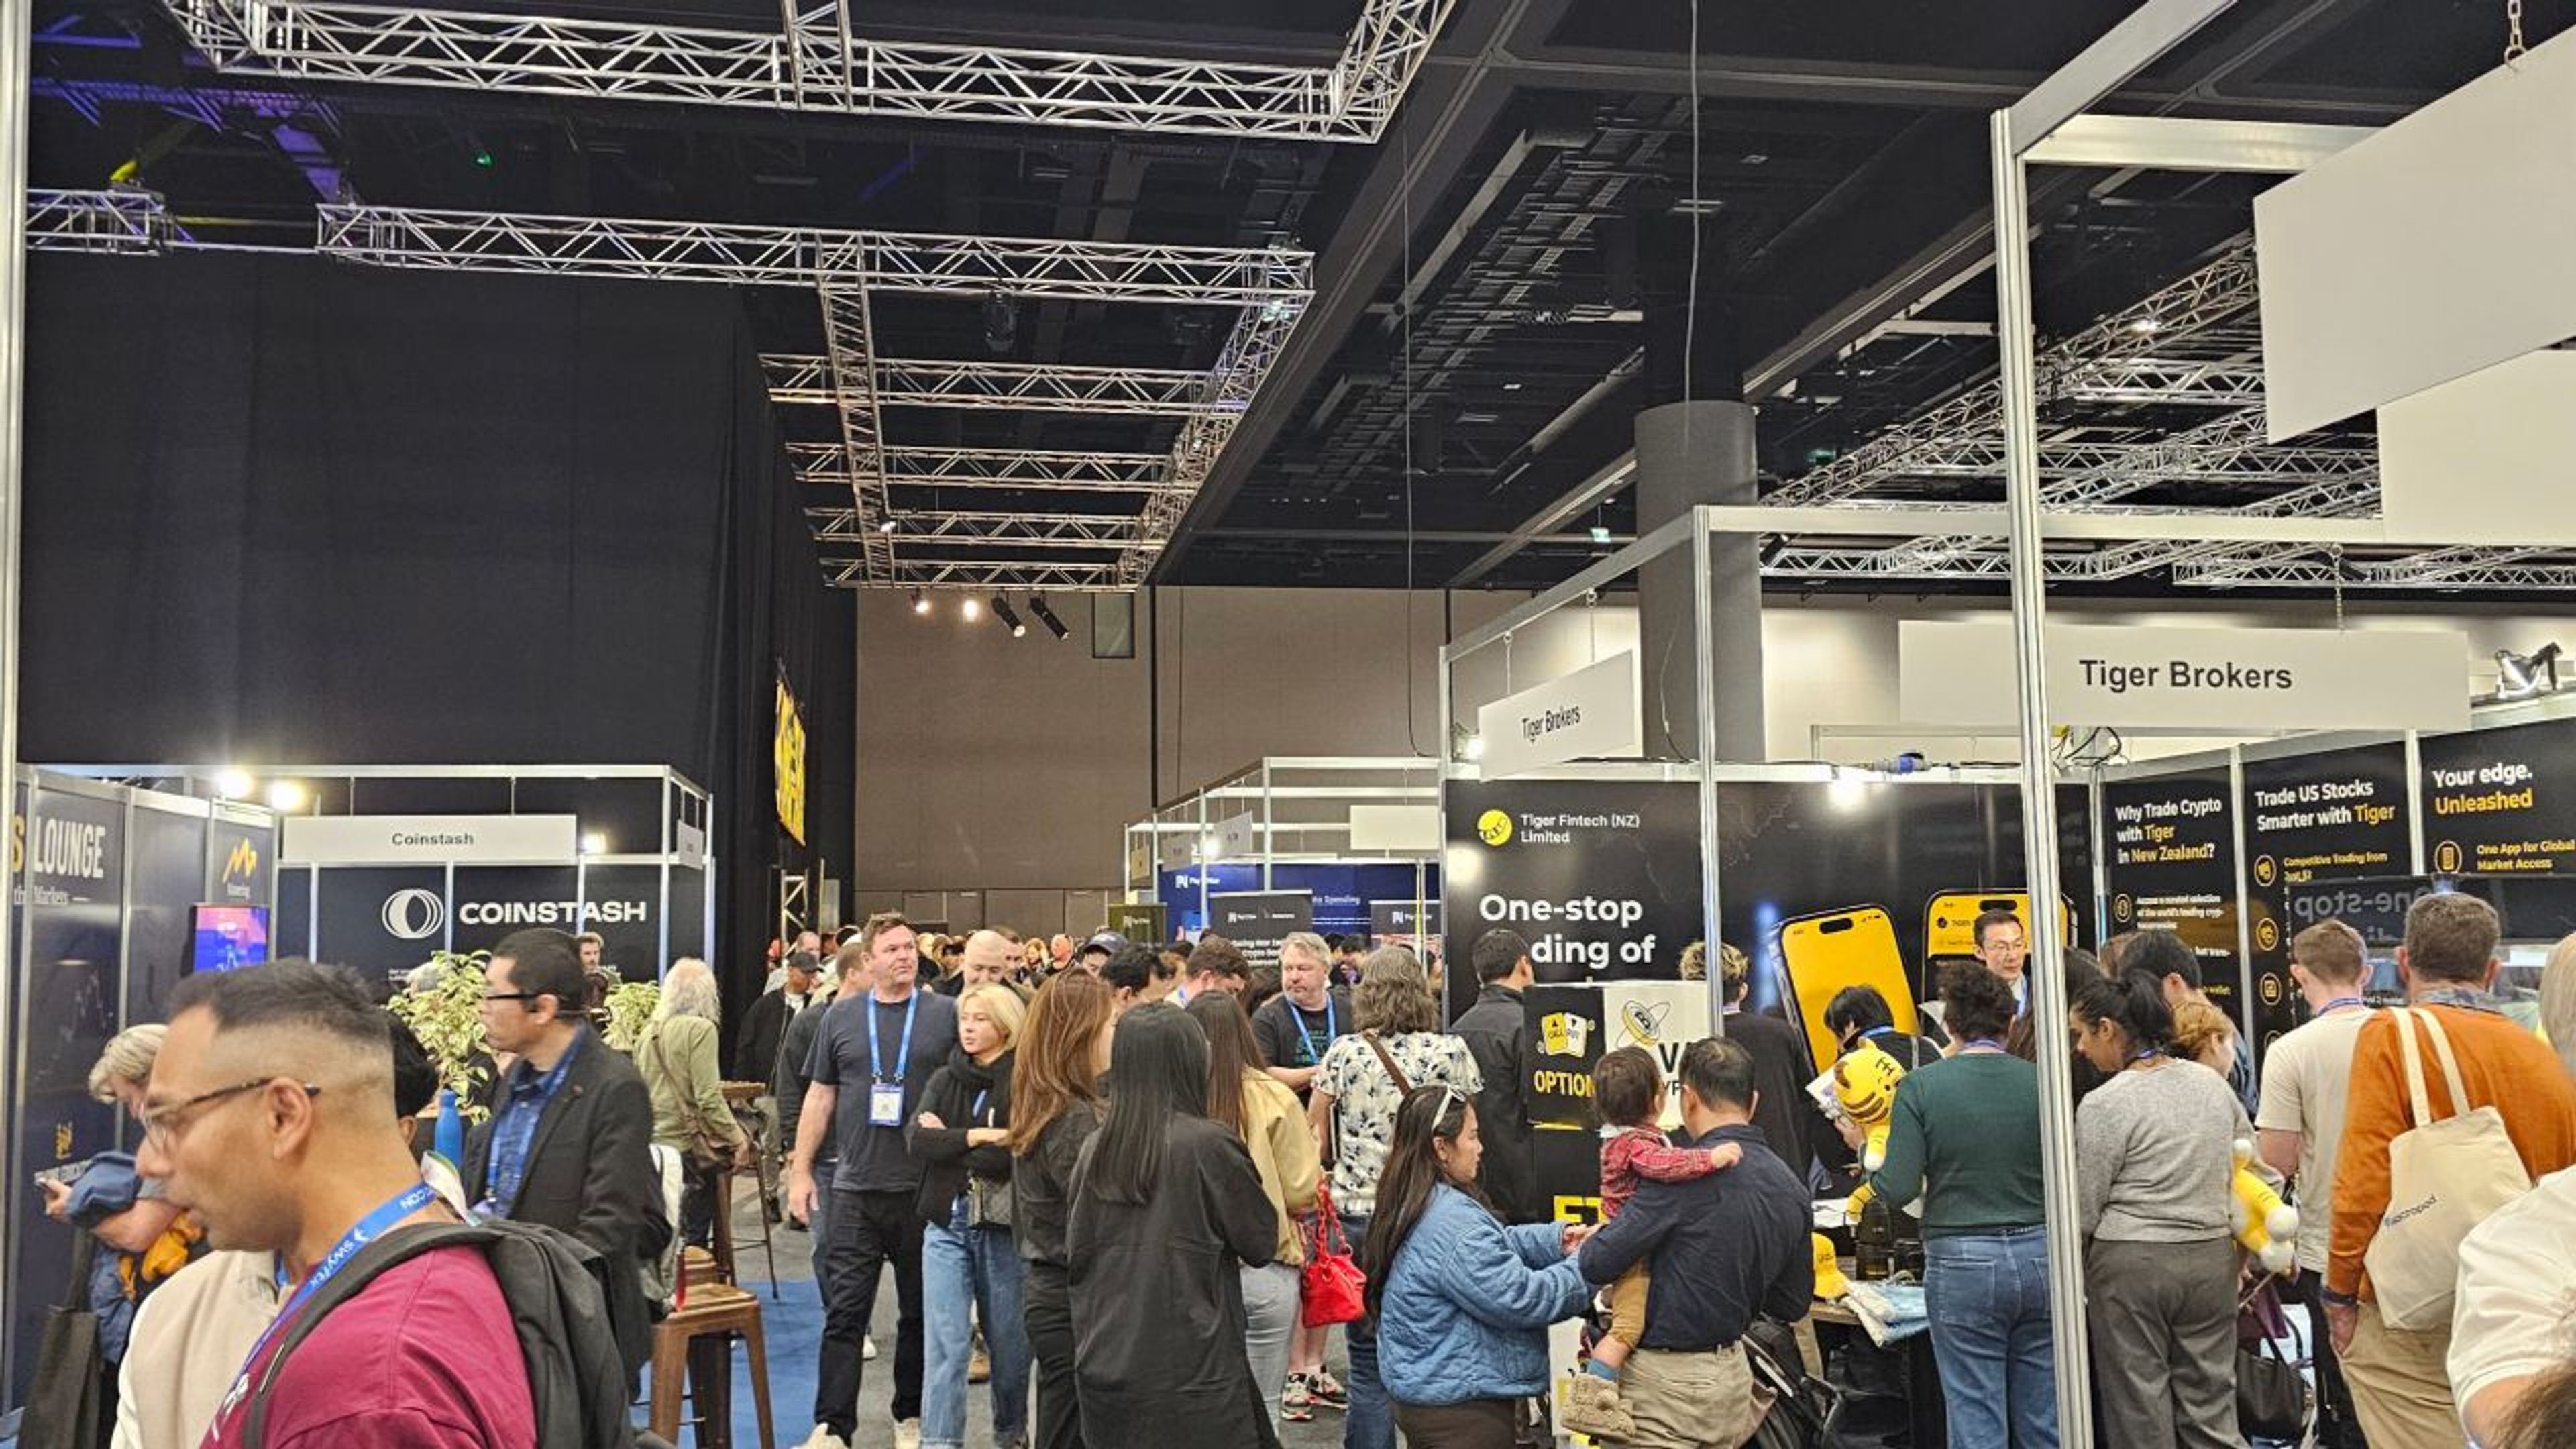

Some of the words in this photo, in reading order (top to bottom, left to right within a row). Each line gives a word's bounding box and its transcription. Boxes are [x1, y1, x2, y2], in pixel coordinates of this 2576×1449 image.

[2079, 659, 2159, 693] Tiger
[2170, 661, 2292, 689] Brokers
[1521, 717, 1544, 744] Tiger
[1545, 704, 1580, 733] Brokers
[2432, 769, 2476, 788] Your
[2479, 762, 2533, 786] edge.
[2255, 788, 2296, 808] Trade
[2299, 784, 2320, 802] US
[2322, 778, 2374, 800] Stocks
[2434, 787, 2534, 814] Unleashed
[1520, 813, 1556, 829] Tiger
[1560, 813, 1607, 827] Fintech
[1611, 813, 1640, 828] (NZ)
[2115, 805, 2143, 823] Why
[2144, 801, 2178, 818] Trade
[2181, 798, 2222, 817] Crypto
[2257, 812, 2314, 833] Smarter
[2317, 806, 2352, 826] with
[2354, 803, 2396, 825] Tiger
[392, 832, 474, 846] Coinstash
[1521, 830, 1570, 843] Limited
[2116, 825, 2143, 843] with
[2145, 823, 2175, 843] Tiger
[34, 816, 106, 879] LOUNGE
[2117, 848, 2130, 865] in
[2131, 848, 2158, 863] New
[2159, 843, 2216, 861] Zealand?
[2477, 845, 2499, 855] One
[2500, 843, 2522, 856] App
[2523, 841, 2539, 853] for
[2540, 839, 2575, 853] Global
[459, 901, 647, 925] COINSTASH
[1479, 894, 1643, 928] One-stop
[1531, 934, 1609, 969] ding
[1619, 934, 1656, 963] of
